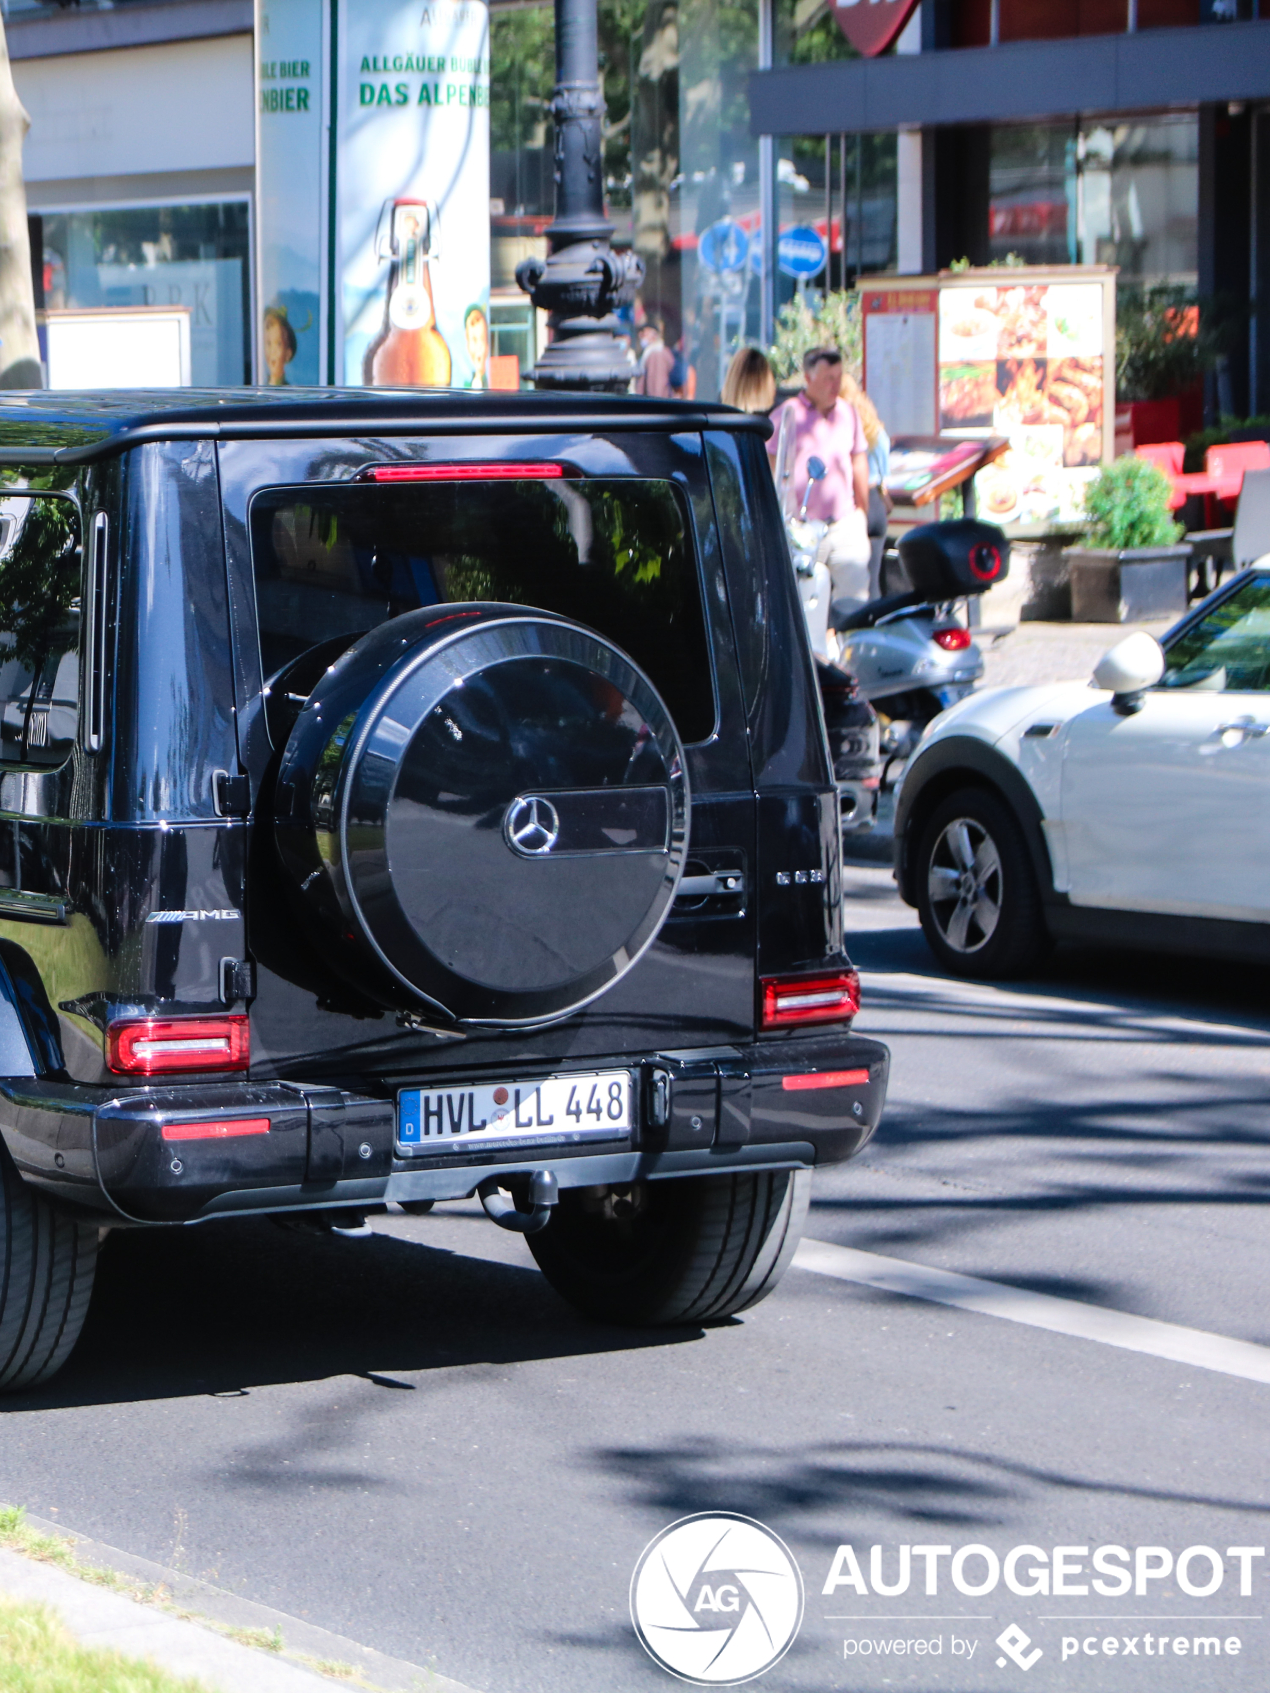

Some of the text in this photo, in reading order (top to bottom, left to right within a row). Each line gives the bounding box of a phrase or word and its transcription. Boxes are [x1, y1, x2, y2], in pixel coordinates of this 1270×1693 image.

[279, 59, 310, 79] BIER
[359, 52, 446, 73] ALLGÄUER
[359, 82, 409, 107] DAS
[180, 908, 241, 921] AMG
[423, 1080, 623, 1135] HVL LL 448
[405, 1122, 415, 1136] D
